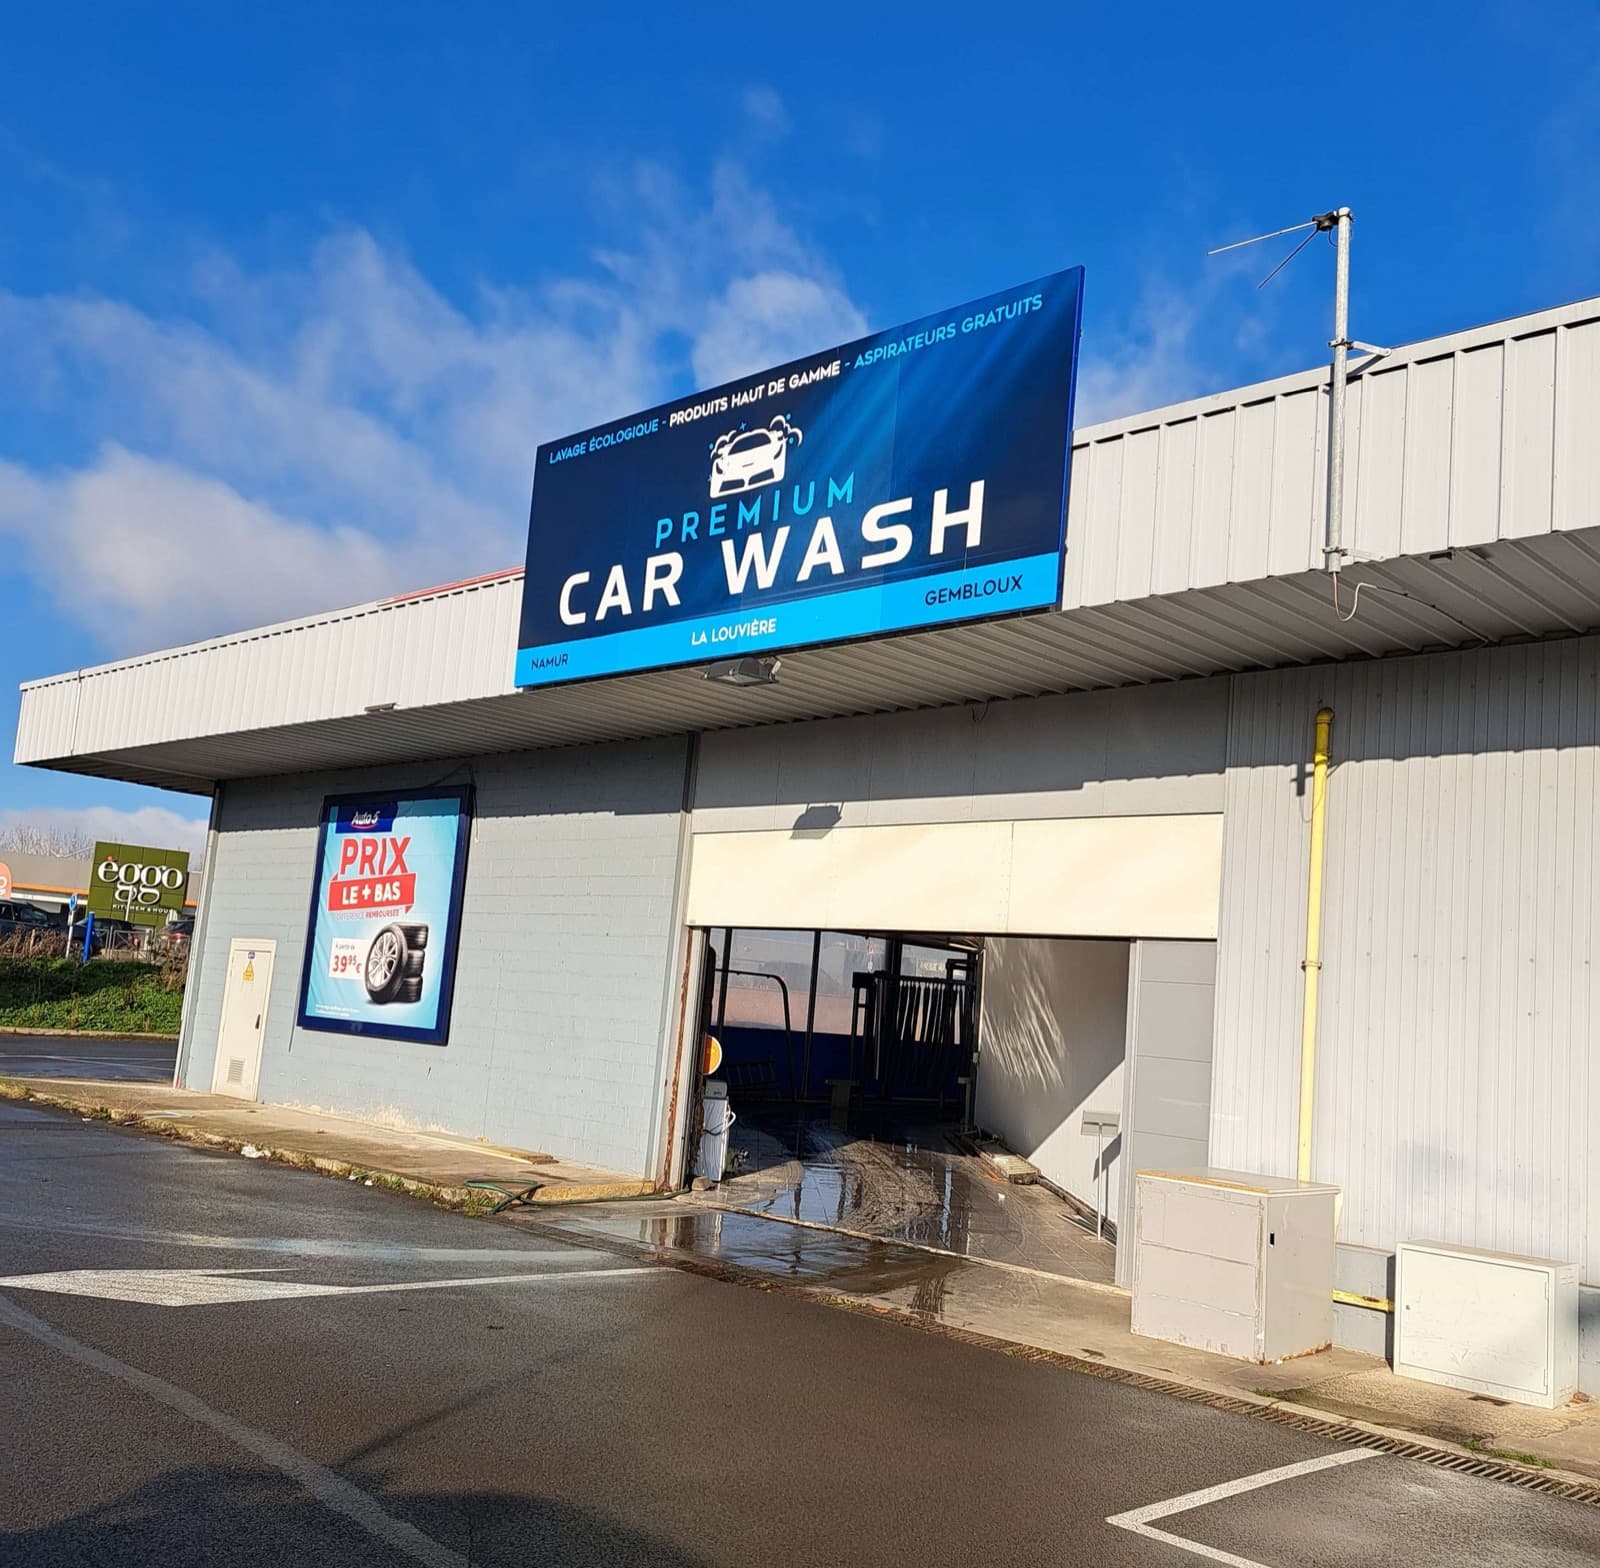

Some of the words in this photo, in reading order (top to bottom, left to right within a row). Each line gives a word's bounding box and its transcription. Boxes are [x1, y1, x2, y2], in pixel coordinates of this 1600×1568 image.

[549, 444, 586, 464] LAVAGE
[589, 418, 659, 451] ÉCOLOGIQUE
[669, 396, 728, 428] PRODUITS
[731, 385, 764, 408] HAUT
[767, 378, 785, 397] DE
[789, 360, 840, 390] GAMME
[854, 323, 956, 369] ASPIRATEURS
[961, 294, 1042, 334] GRATUITS
[655, 471, 854, 548] PREMIUM
[559, 551, 684, 626] CAR
[721, 479, 985, 596] WASH
[925, 574, 1023, 606] GEMBLOUX
[691, 631, 707, 646] LA
[711, 618, 777, 642] LOUVIÈRE
[531, 653, 568, 669] NAMUR
[351, 811, 371, 825] Auto
[341, 837, 411, 875] PRIX
[113, 904, 145, 912] KITHEN
[342, 886, 359, 905] LE
[374, 881, 400, 902] BAS
